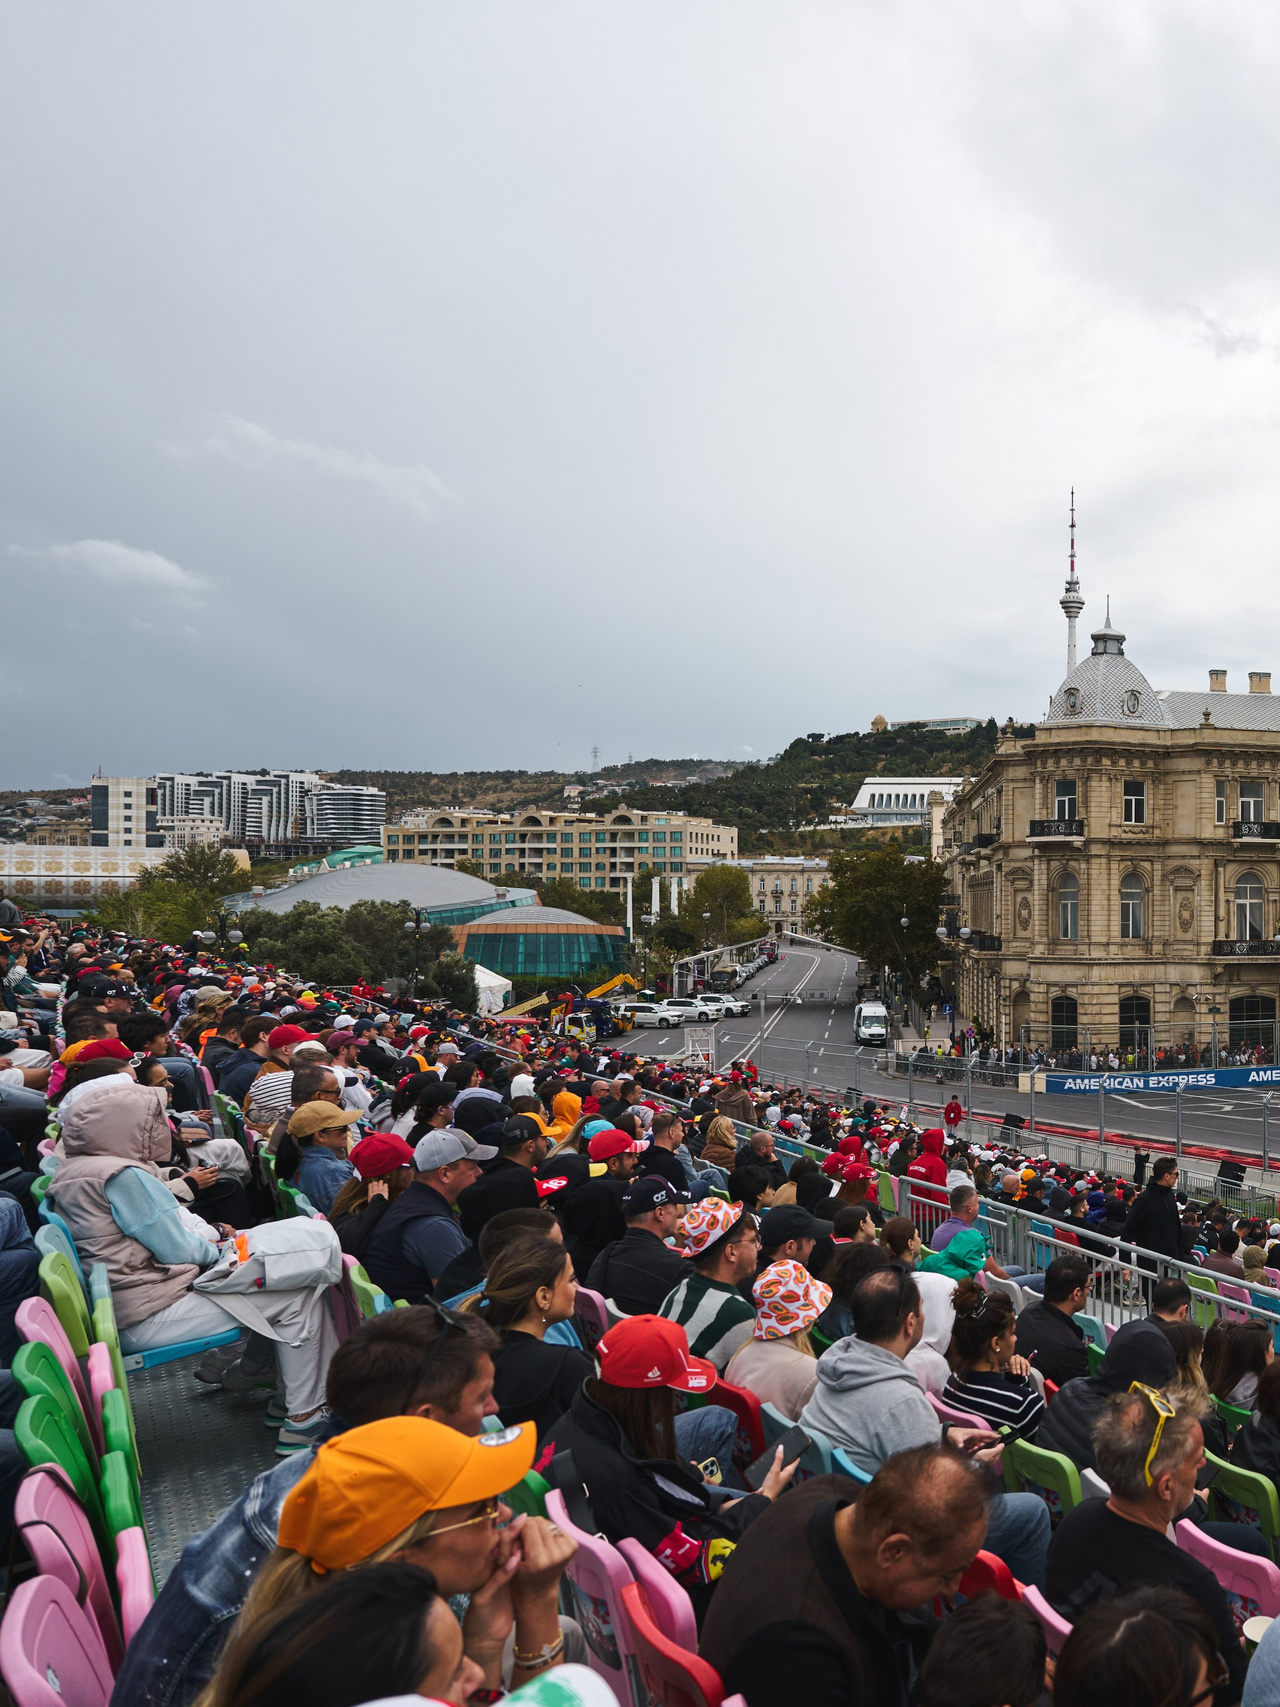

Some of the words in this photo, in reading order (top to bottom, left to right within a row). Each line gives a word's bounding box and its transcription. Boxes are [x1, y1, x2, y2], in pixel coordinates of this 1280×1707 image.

[1064, 1077, 1144, 1090] AMERICAN
[1149, 1073, 1215, 1088] EXPRESS
[542, 1179, 567, 1190] 16
[687, 1375, 707, 1388] 16
